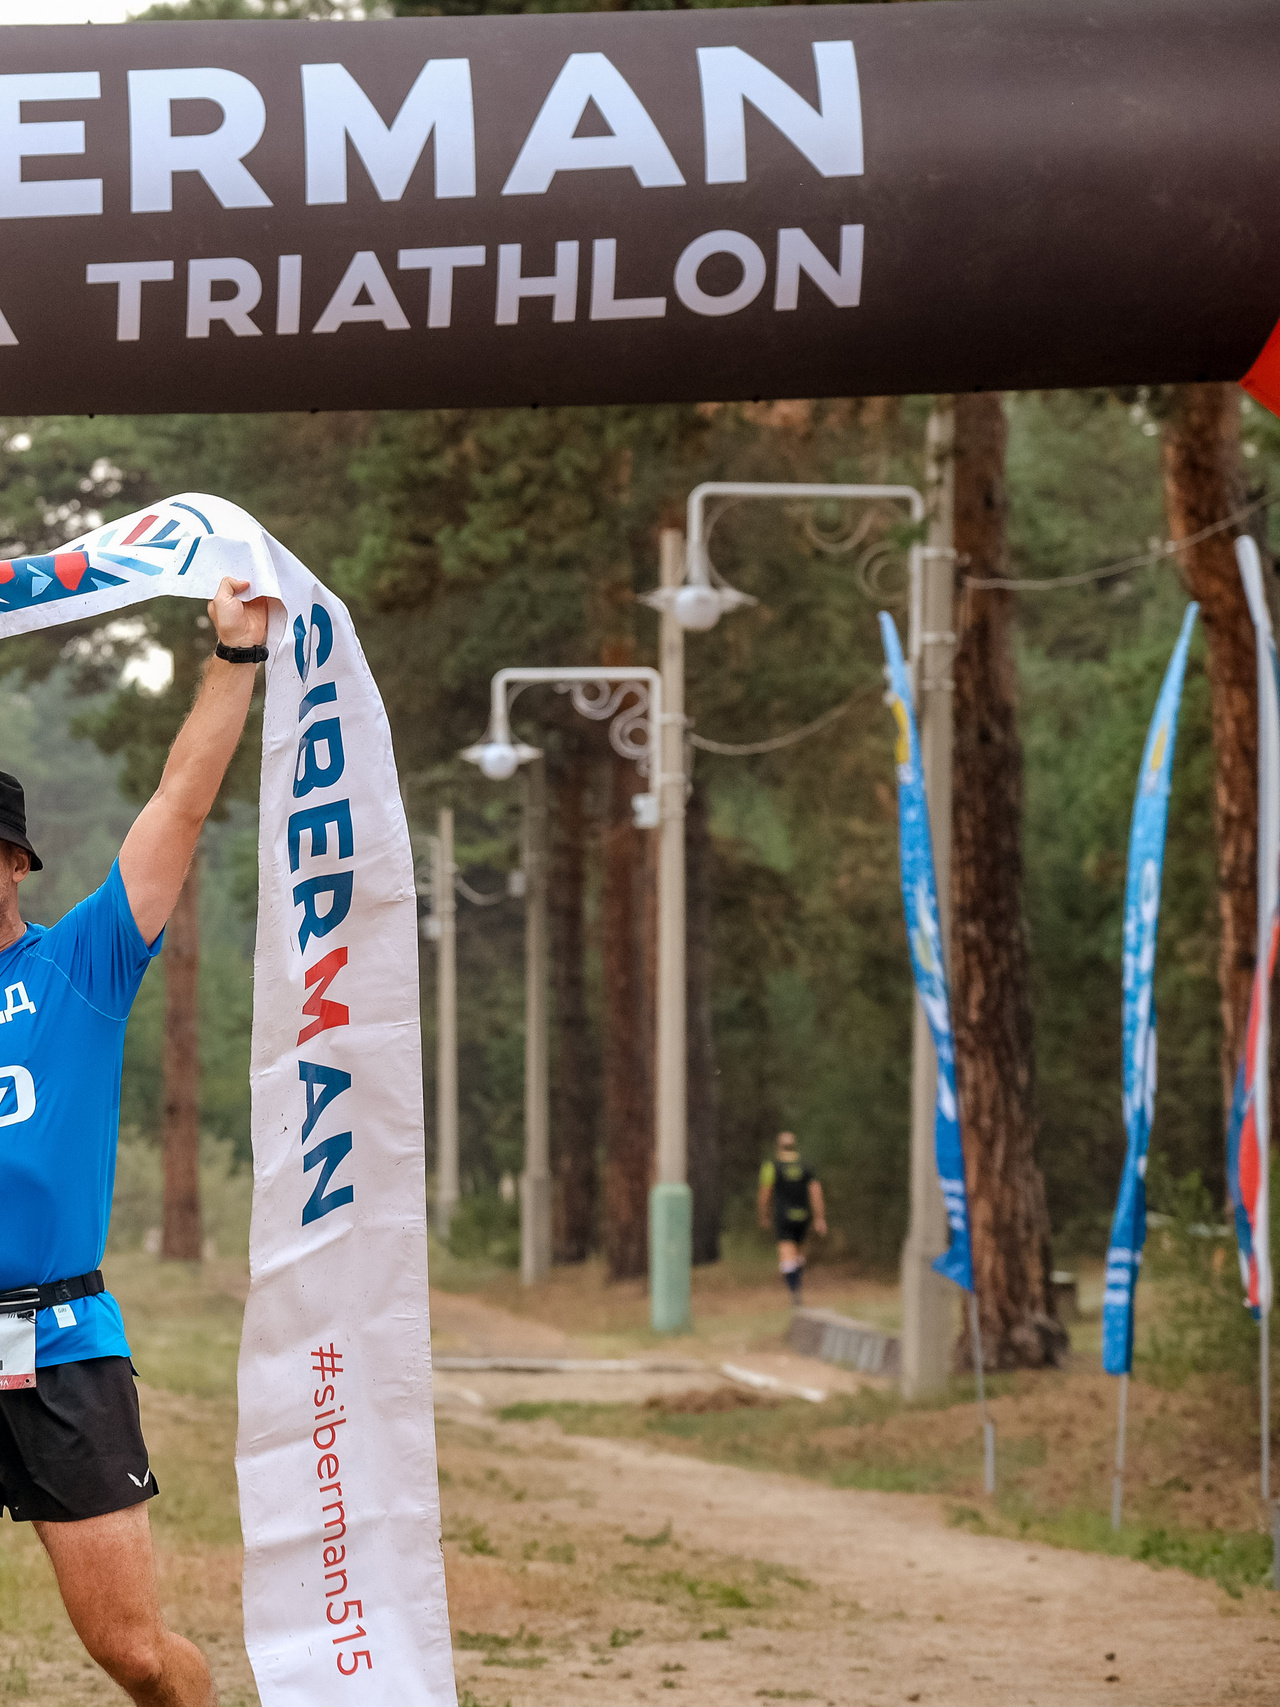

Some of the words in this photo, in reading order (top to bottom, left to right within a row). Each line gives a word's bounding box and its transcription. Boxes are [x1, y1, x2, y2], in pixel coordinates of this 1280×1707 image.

[86, 224, 865, 341] TRIATHLON
[287, 603, 355, 1227] SIBERMAN
[310, 1342, 373, 1677] #siberman515
